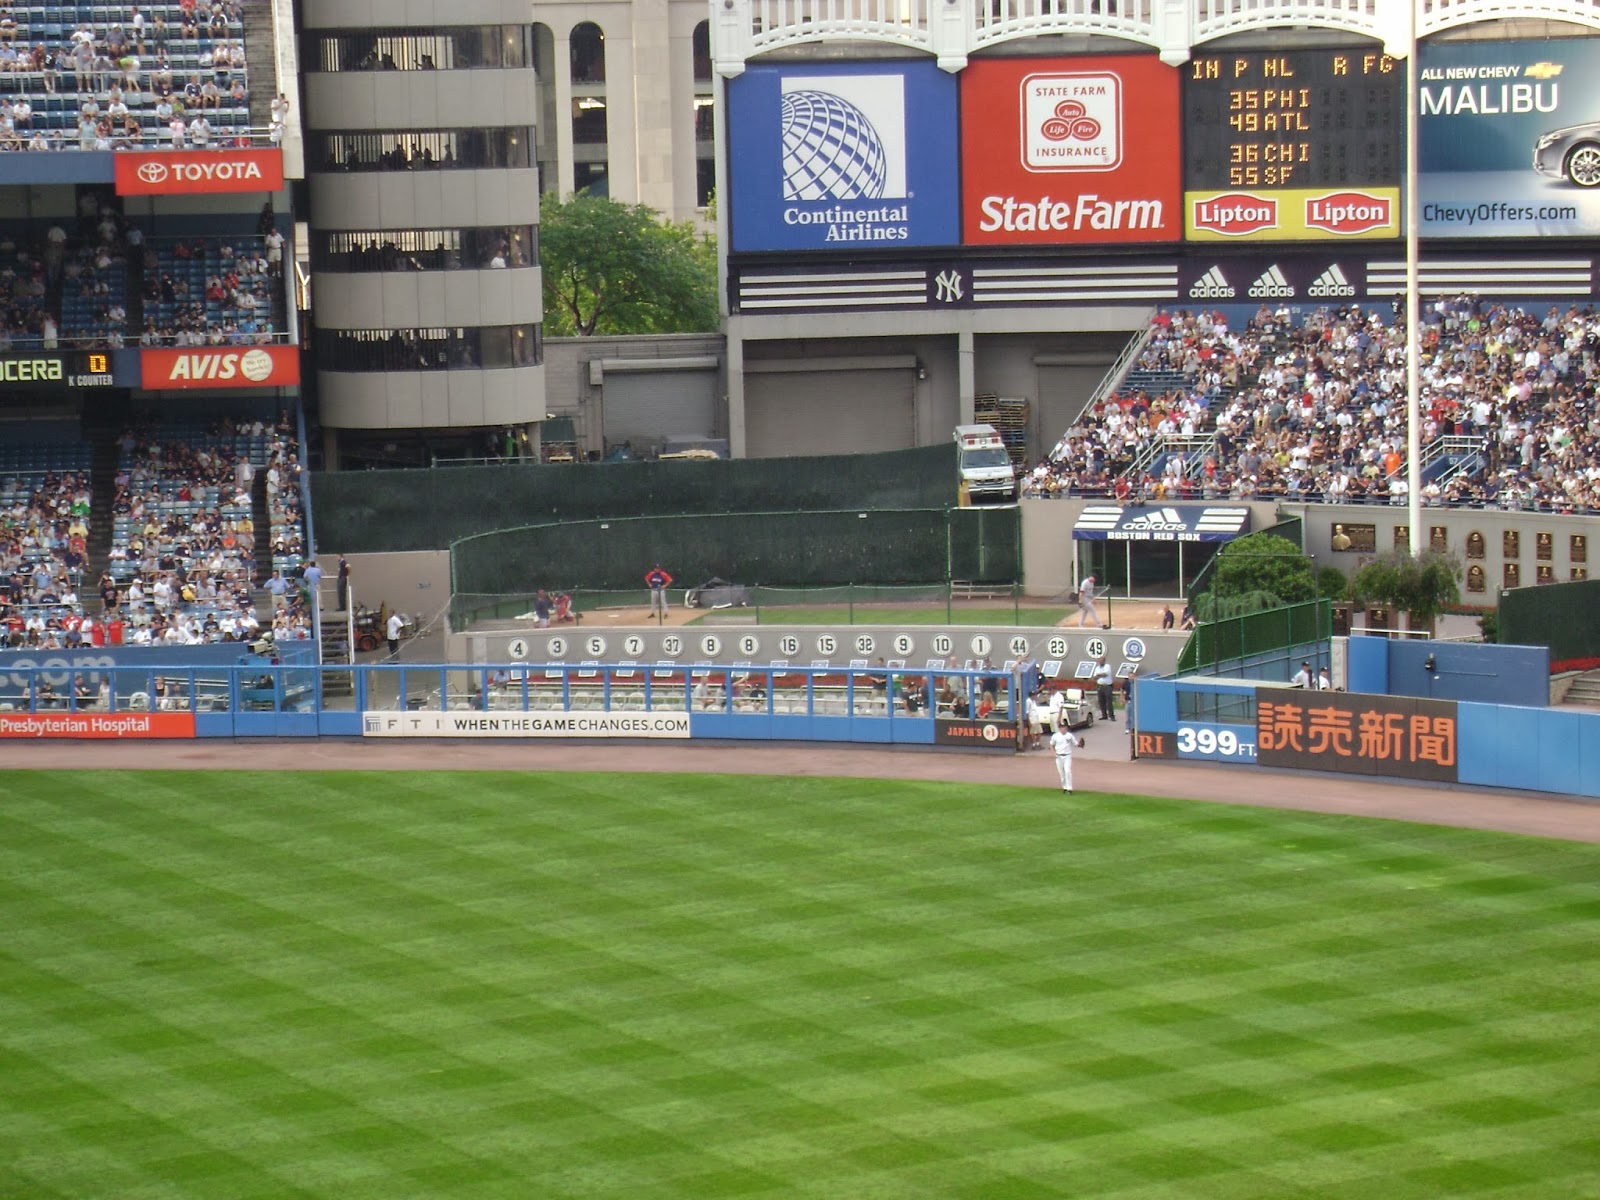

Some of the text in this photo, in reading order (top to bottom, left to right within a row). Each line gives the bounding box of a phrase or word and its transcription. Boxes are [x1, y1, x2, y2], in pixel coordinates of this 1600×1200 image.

[1193, 60, 1219, 79] IN
[1235, 60, 1247, 78] P
[1264, 59, 1294, 77] NL
[1334, 57, 1347, 75] R
[1421, 66, 1520, 80] ALL NEW CHEVY
[1036, 86, 1106, 96] STATE FARM
[1230, 89, 1309, 110] 35 PHI
[1420, 83, 1558, 115] MALIBU
[1230, 112, 1309, 131] 49 ATL
[1049, 126, 1065, 135] Life
[1036, 147, 1107, 157] INSURANCE
[1230, 143, 1309, 163] 36 CHI
[171, 162, 262, 181] TOYOTA
[1230, 166, 1294, 185] 55 SF
[783, 205, 908, 225] Continental
[979, 194, 1163, 232] State Farm
[1200, 204, 1271, 227] Lipton
[1312, 202, 1384, 226] Lipton
[1423, 203, 1577, 225] ChevyOffers.com
[825, 224, 908, 242] Airlines
[1189, 286, 1236, 298] adidas
[1248, 285, 1295, 298] adidas
[1308, 284, 1356, 297] adidas
[169, 353, 238, 380] AVIS
[68, 374, 113, 387] K COUNTER
[1122, 521, 1187, 531] adidas
[1107, 531, 1201, 541] BOSTON RED SOX
[665, 639, 679, 651] 37
[783, 639, 796, 651] 16
[820, 639, 833, 651] 15
[859, 639, 872, 650] 32
[936, 639, 949, 651] 10
[1013, 639, 1026, 652] 44
[1051, 641, 1064, 653] 23
[1089, 642, 1103, 655] 49
[0, 716, 150, 737] Presbyterian Hospital
[947, 727, 982, 737] JAPAN'S
[1257, 702, 1455, 766] 読売新聞
[1138, 735, 1164, 754] RI
[1177, 727, 1258, 756] 399 FT.
